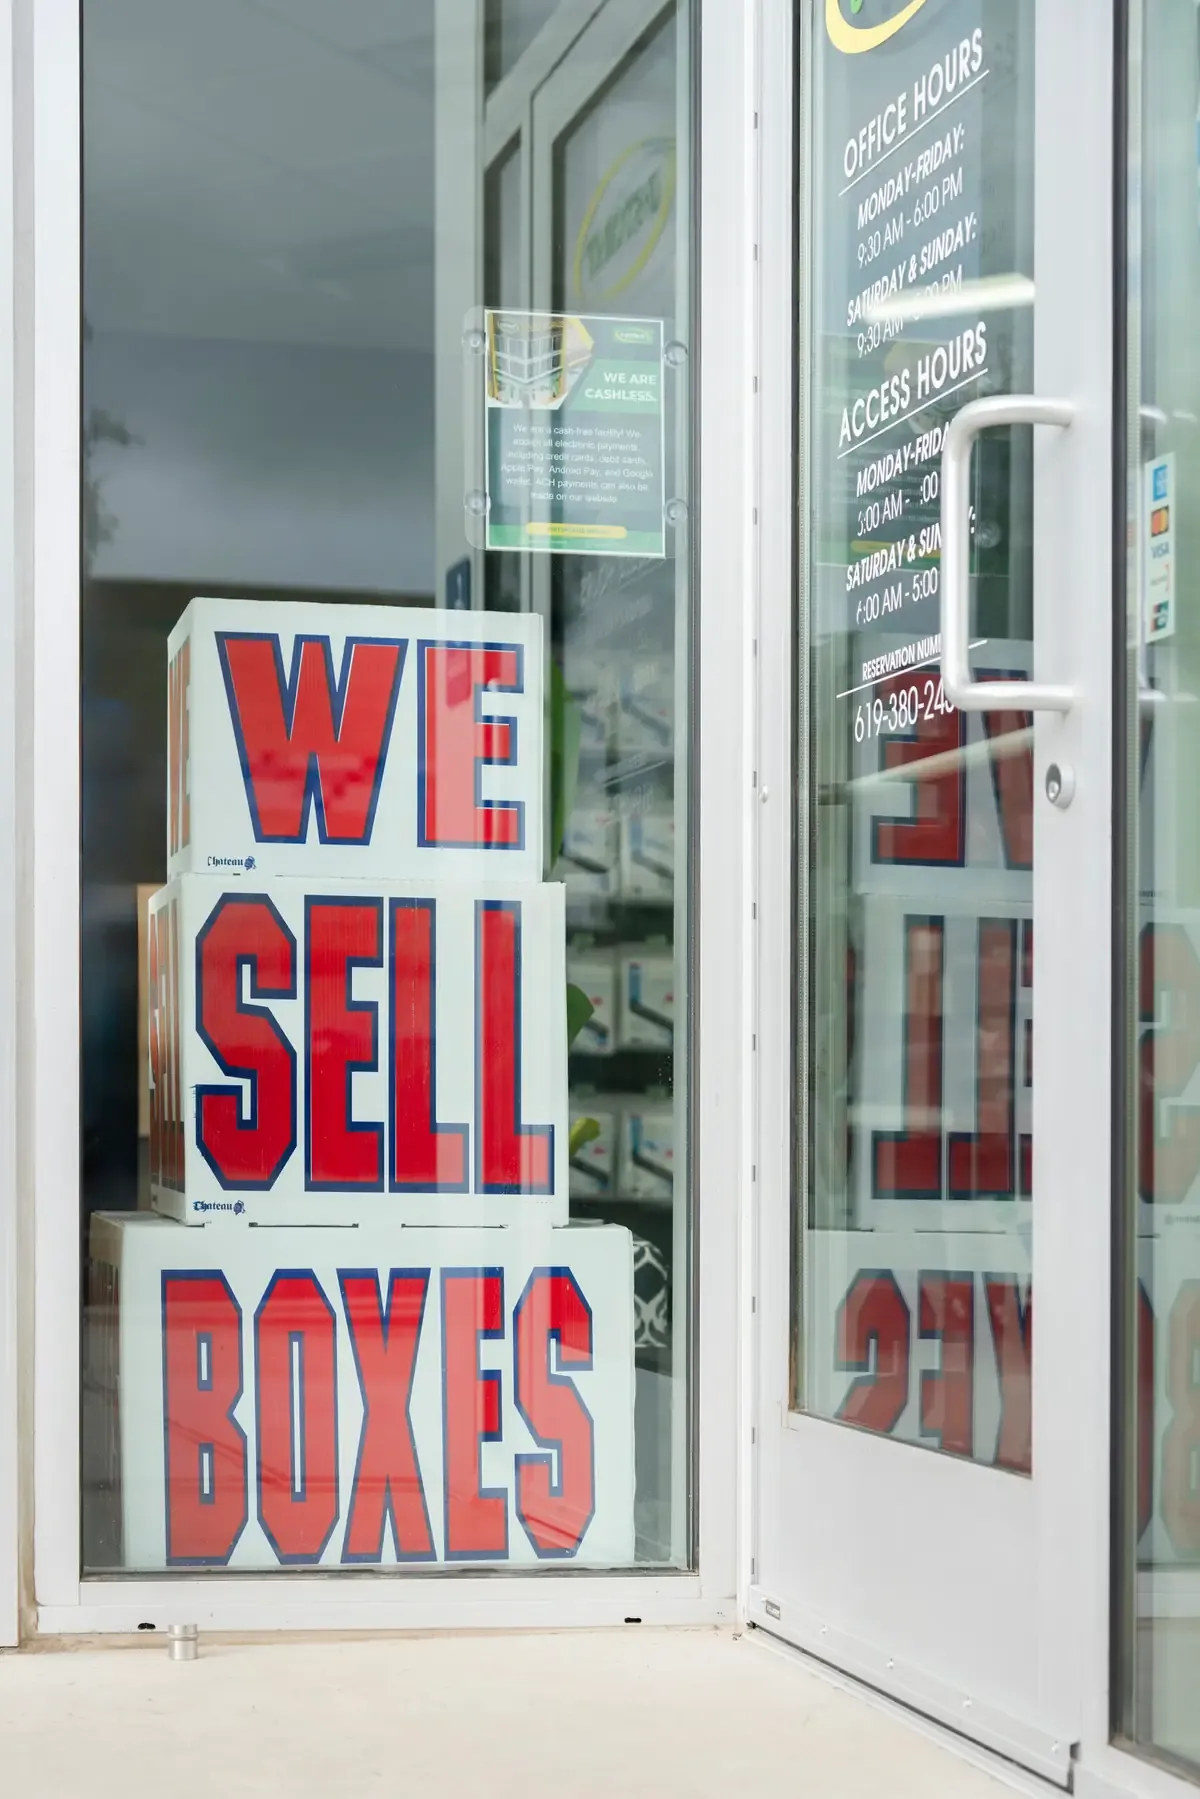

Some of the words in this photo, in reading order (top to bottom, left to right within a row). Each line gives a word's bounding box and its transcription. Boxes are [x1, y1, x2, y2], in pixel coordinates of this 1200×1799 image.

[844, 92, 907, 177] OFFICE
[914, 28, 983, 121] HOURS
[857, 123, 965, 230] MONDAY-FRIDAY:
[857, 231, 881, 269] 9:30
[882, 212, 904, 250] AM
[913, 185, 940, 227] 6:00
[942, 167, 963, 206] PM
[846, 260, 907, 326] SATURDAY
[907, 254, 917, 283] &
[919, 212, 977, 275] SUNDAY:
[603, 371, 627, 384] WE
[629, 373, 657, 386] ARE
[857, 322, 881, 358] 9:30
[839, 368, 911, 448] ACCESS
[917, 321, 986, 400] HOURS
[881, 489, 903, 524] AM
[846, 538, 907, 592] SATURDAY
[907, 534, 916, 563] &
[881, 582, 902, 615] AM
[912, 567, 938, 602] 5:00
[862, 643, 915, 681] RESERVATION
[214, 630, 525, 851] WE
[207, 855, 244, 867] Chateau
[194, 892, 555, 1196] SELL
[192, 1200, 233, 1212] Chateau
[160, 1265, 596, 1567] BOXES
